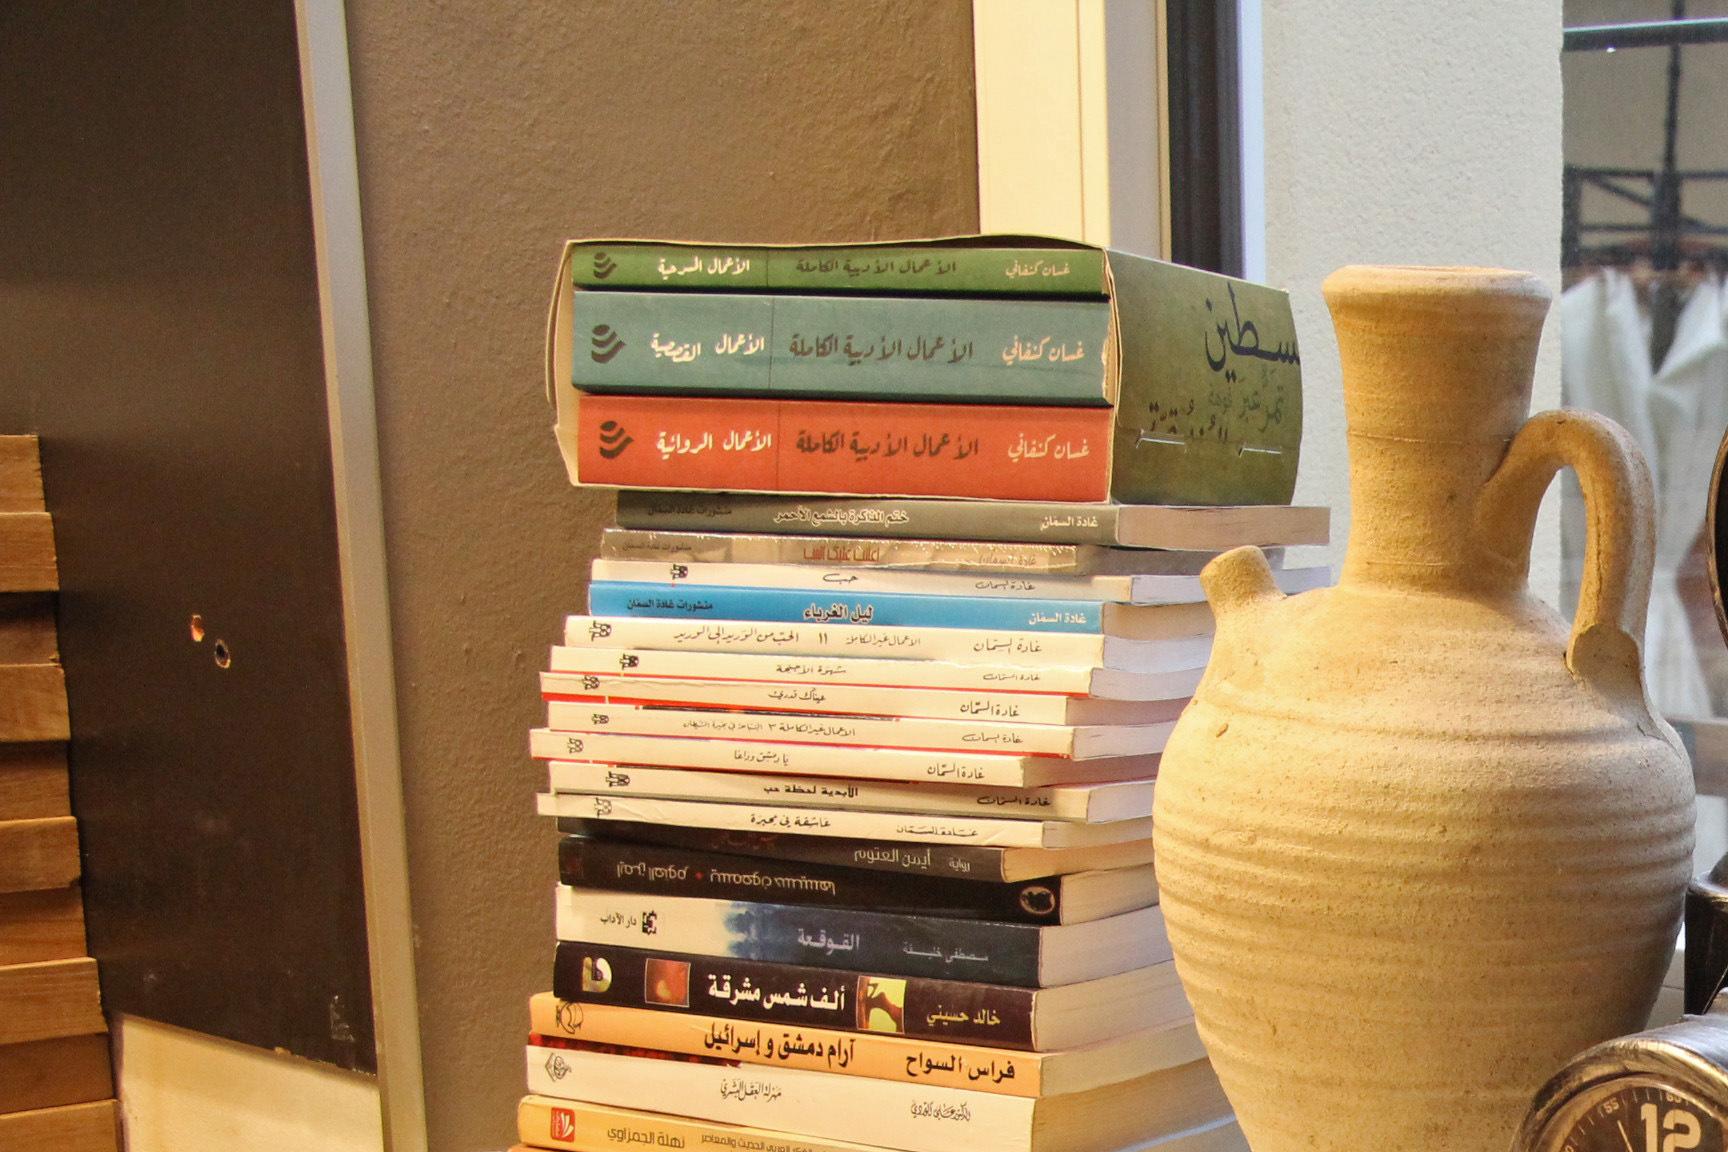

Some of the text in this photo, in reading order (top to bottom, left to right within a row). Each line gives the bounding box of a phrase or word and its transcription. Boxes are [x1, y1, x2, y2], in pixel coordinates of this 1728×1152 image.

[795, 259, 839, 274] الكاملة
[1004, 259, 1071, 279] غسان كنفاني
[650, 333, 702, 361] القصصية
[789, 333, 839, 358] الكاملة
[1002, 335, 1086, 366] غسان كنفاني
[656, 431, 713, 460] الروائية
[795, 431, 845, 454] الكاملة
[1007, 433, 1090, 463] غسان كنفاني
[811, 507, 848, 527] بالشمع
[848, 509, 885, 524] الذاكرة
[884, 509, 909, 527] ختم
[1075, 515, 1098, 528] غادة
[822, 572, 858, 583] حب
[803, 603, 874, 623] ليل الغرباء
[1064, 612, 1088, 624] غادة
[1015, 638, 1043, 653] غادة
[995, 704, 1021, 717] غادة
[961, 766, 985, 779] غادة
[763, 787, 780, 795] حب
[784, 784, 817, 795] لحظة
[779, 816, 790, 828] في
[794, 815, 831, 828] عاشقة
[854, 846, 932, 870] أيمن العتوم
[949, 856, 971, 873] رواية
[709, 868, 836, 896] يسمعون حسيسها
[625, 914, 637, 930] دار
[797, 928, 861, 956] القوقعة
[902, 940, 942, 959] خليفة
[707, 973, 846, 1011] ألف شمس مشرقة
[926, 1004, 1001, 1027] خالد حسيني
[704, 1021, 856, 1069] آرام دمشق و إسرائيل
[905, 1051, 1016, 1084] فراس السواح
[1603, 1097, 1620, 1114] 55
[657, 1131, 686, 1149] نهلة
[701, 1133, 737, 1149] والمعاصر
[738, 1139, 765, 1151] الحديث
